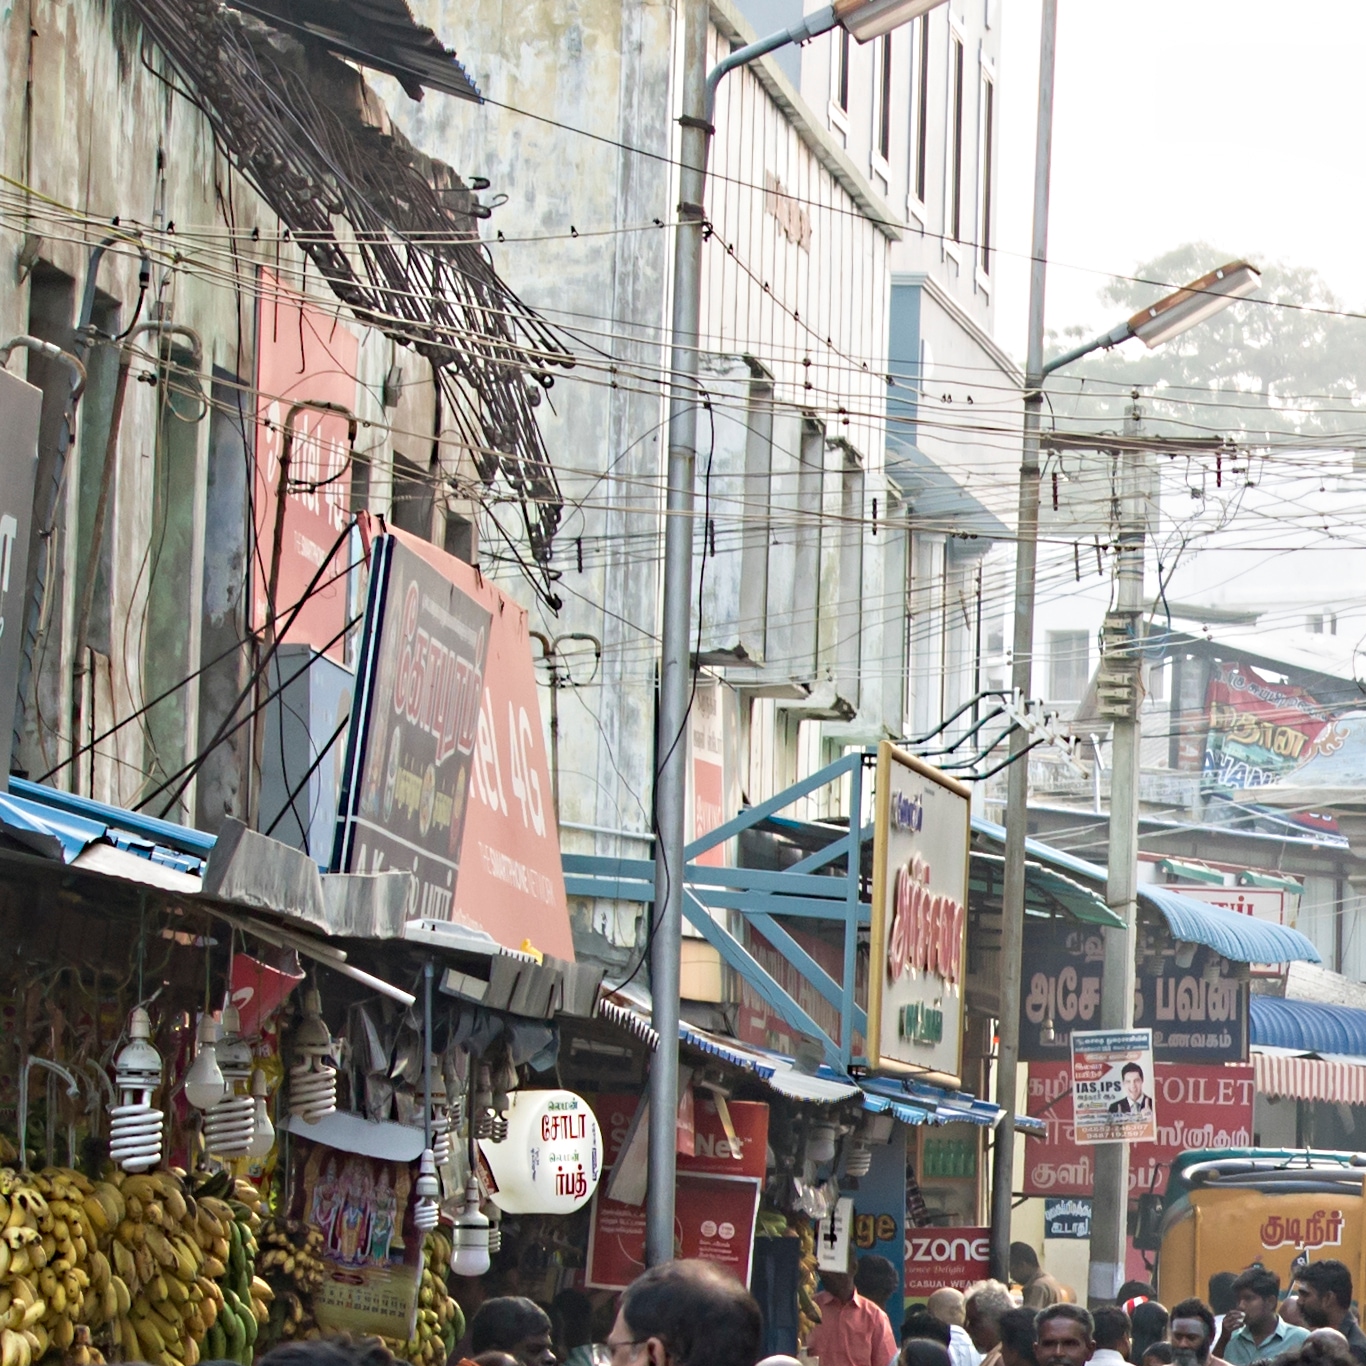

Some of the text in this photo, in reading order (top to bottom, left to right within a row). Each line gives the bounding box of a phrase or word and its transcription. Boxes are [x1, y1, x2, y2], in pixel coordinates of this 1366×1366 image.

[508, 700, 547, 839] 4G
[541, 1114, 587, 1142] சோடா
[1260, 1210, 1345, 1250] குடிநீர்
